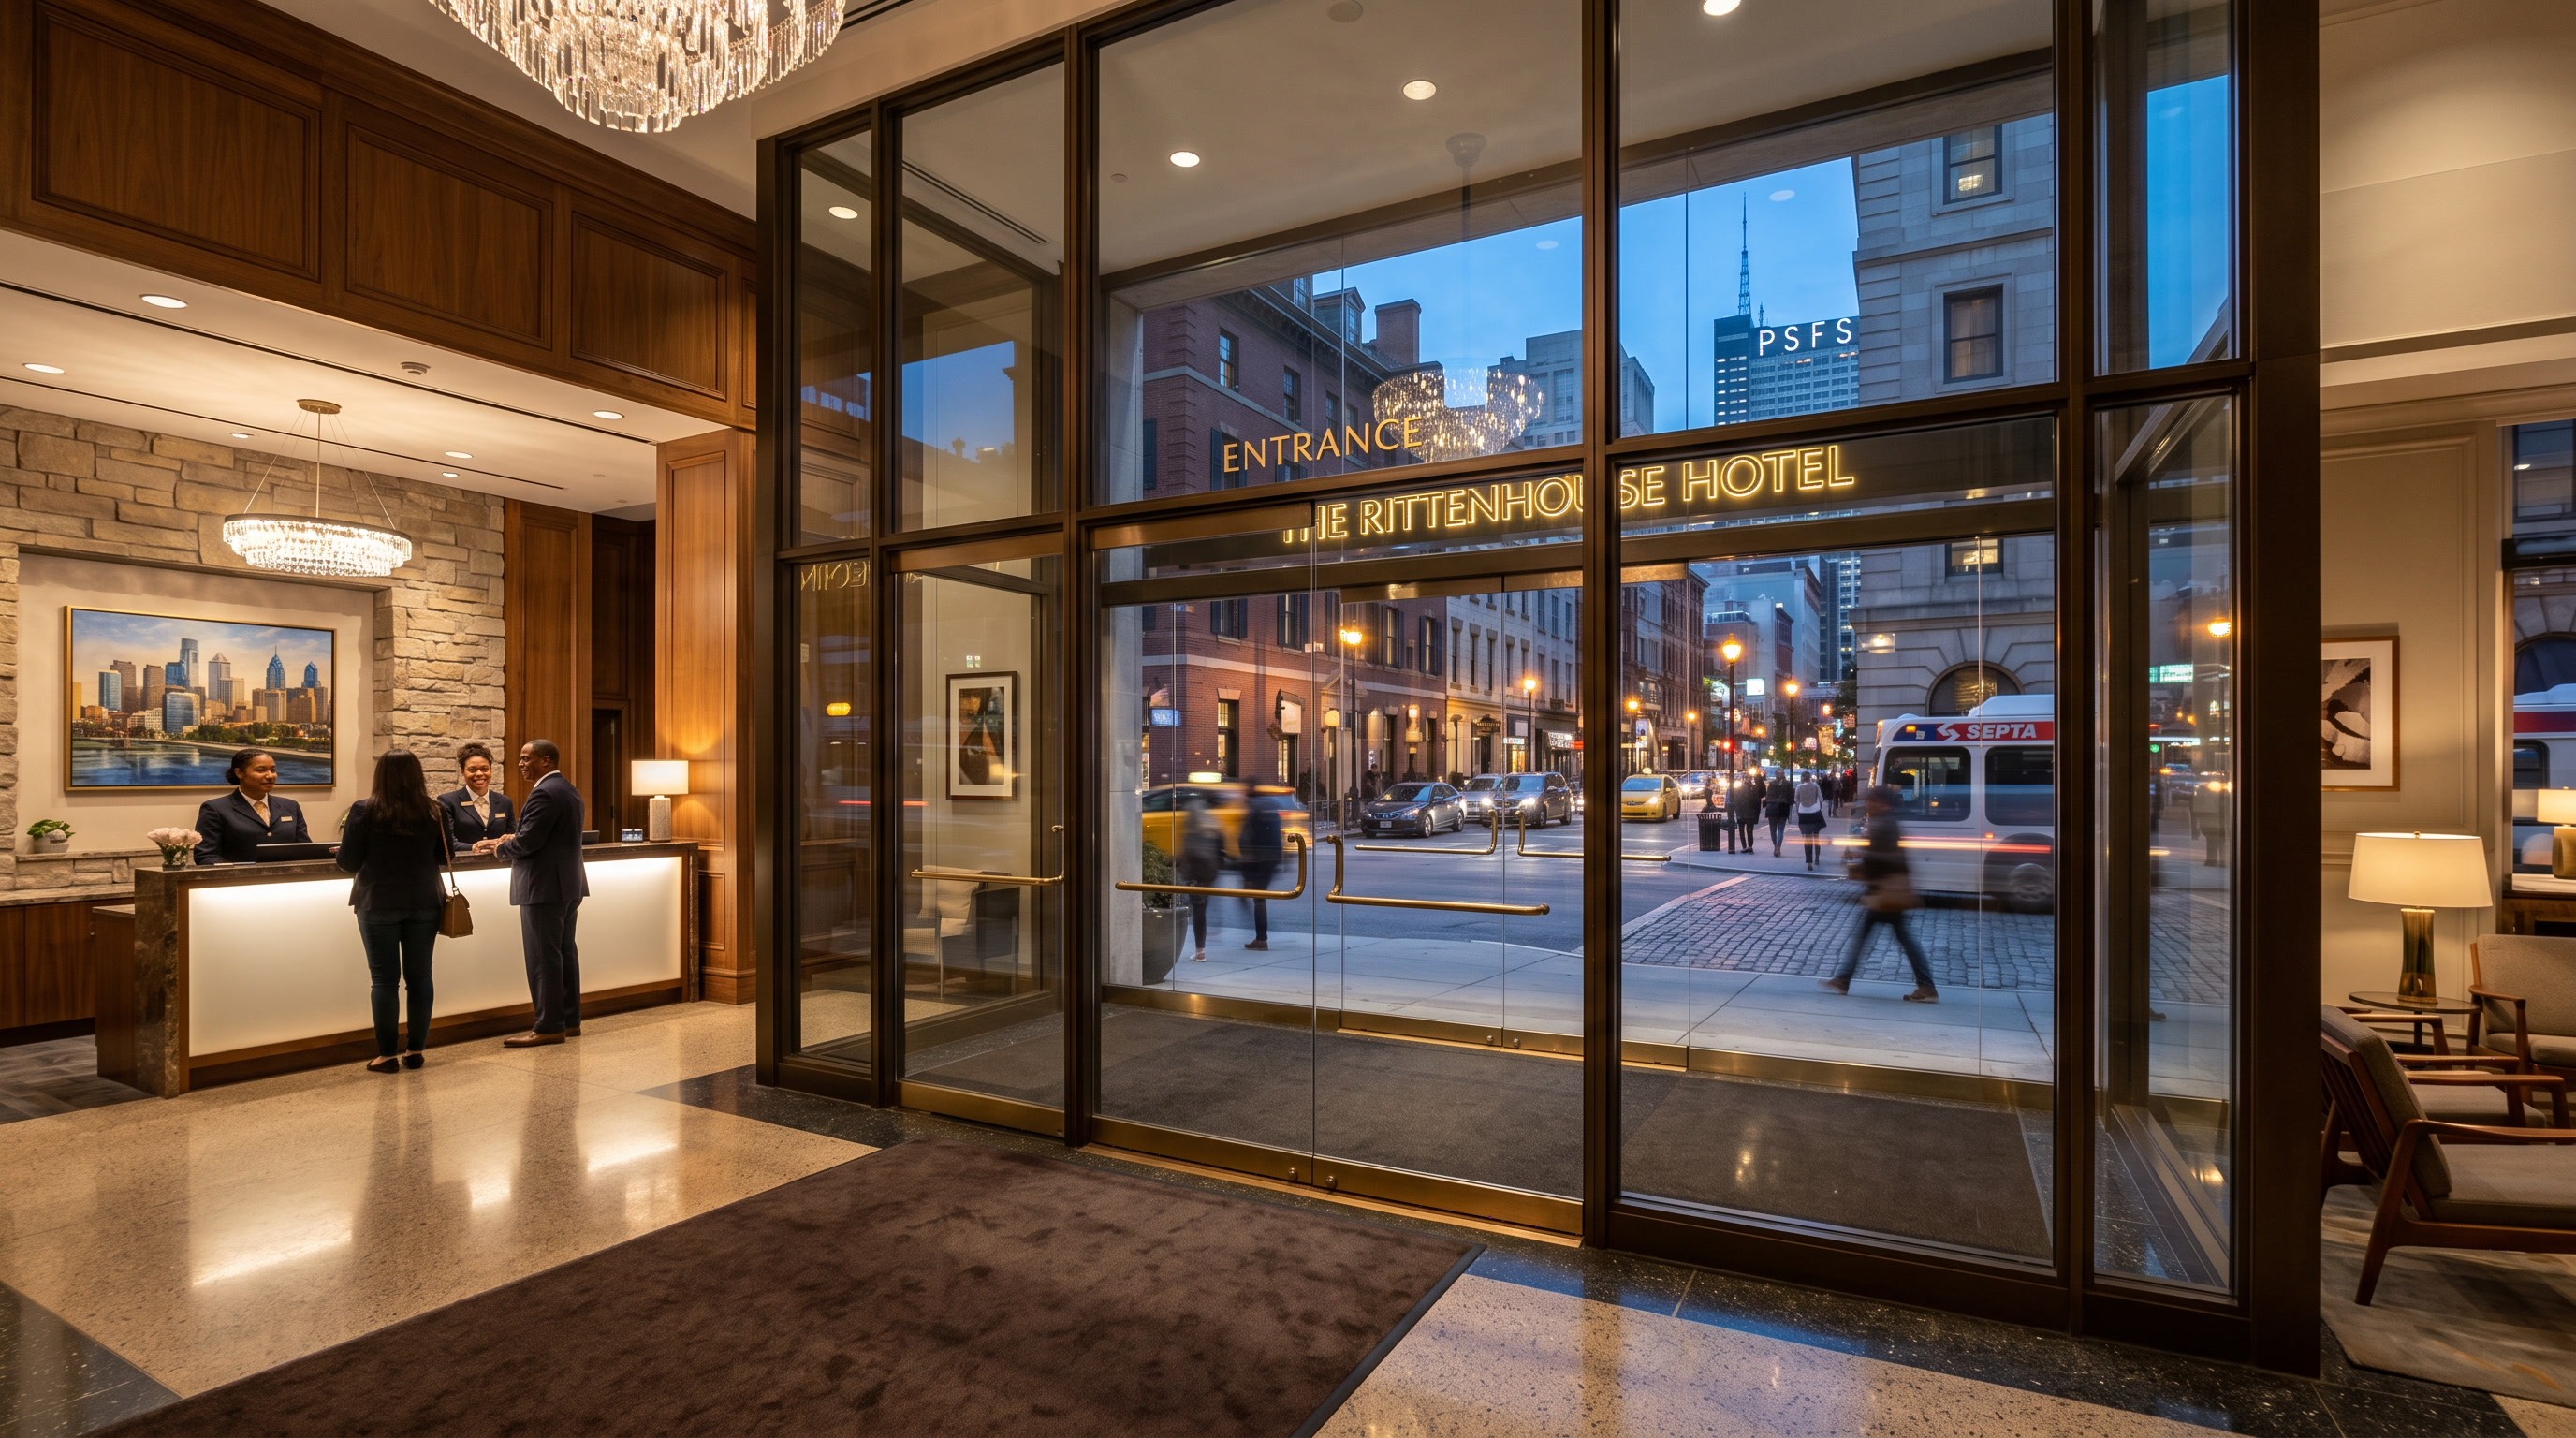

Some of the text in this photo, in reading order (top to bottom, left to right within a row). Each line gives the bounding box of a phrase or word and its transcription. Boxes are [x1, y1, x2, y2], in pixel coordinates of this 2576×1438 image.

[1759, 317, 1852, 357] PSFS
[1223, 416, 1423, 473] ENTRANCE
[1682, 444, 1855, 503] HOTEL
[1967, 724, 2037, 740] SEPTA
